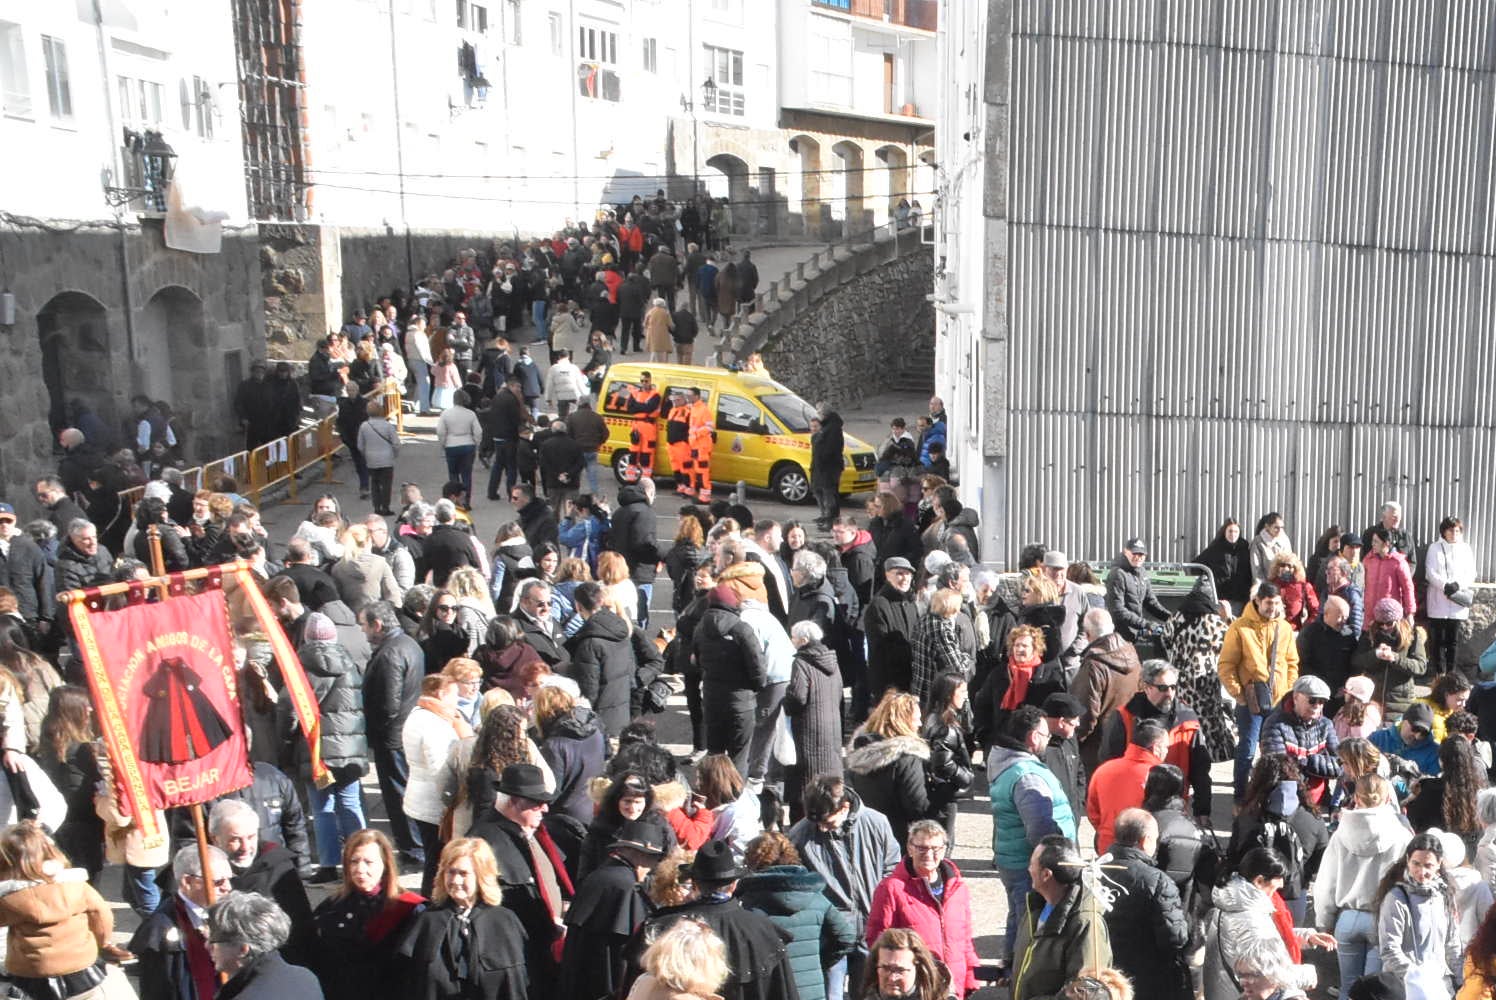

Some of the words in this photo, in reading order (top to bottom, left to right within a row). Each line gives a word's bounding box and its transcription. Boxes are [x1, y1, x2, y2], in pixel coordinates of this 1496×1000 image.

[147, 631, 189, 654] AMIGOS
[190, 635, 208, 653] DE
[208, 647, 224, 666] LA
[222, 665, 237, 700] CAPA
[163, 768, 220, 796] BEJAR
